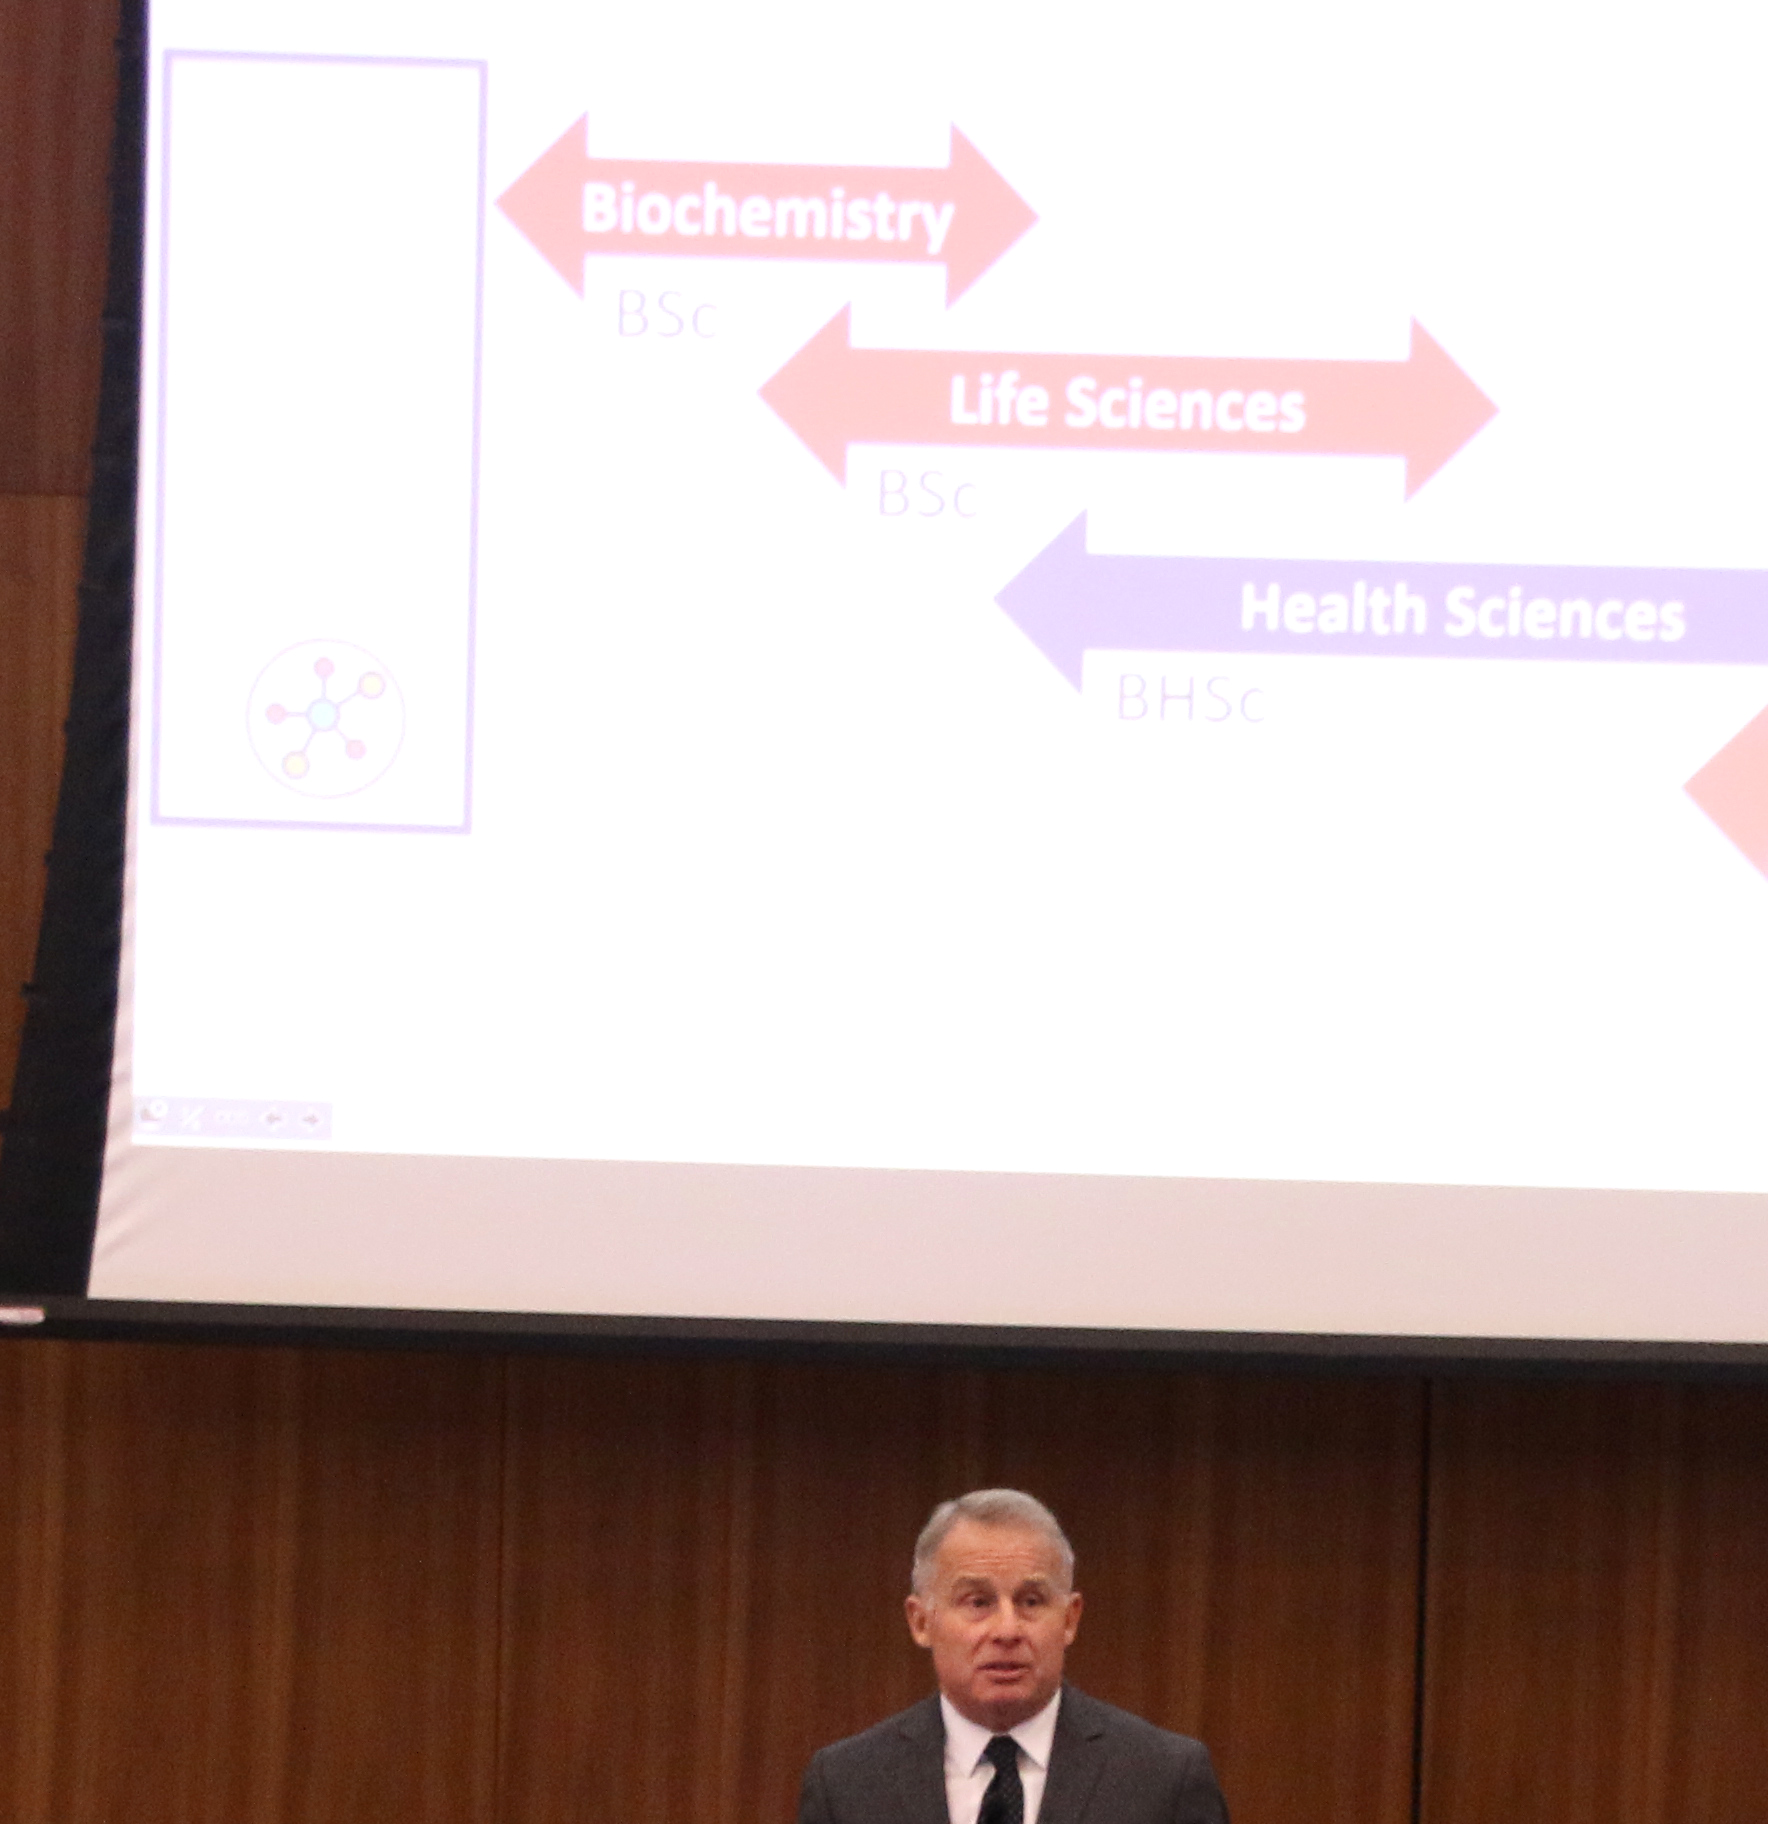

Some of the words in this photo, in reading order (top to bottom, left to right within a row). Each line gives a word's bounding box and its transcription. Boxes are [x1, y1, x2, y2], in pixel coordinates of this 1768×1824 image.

[581, 179, 956, 254] Biochemistry
[616, 288, 716, 339] BSc
[950, 369, 1050, 428] Life
[1064, 375, 1308, 434] Sciences
[876, 468, 976, 519] BSc
[1239, 579, 1428, 637] Health
[1444, 585, 1688, 644] Sciences
[1116, 673, 1267, 724] BHSc
